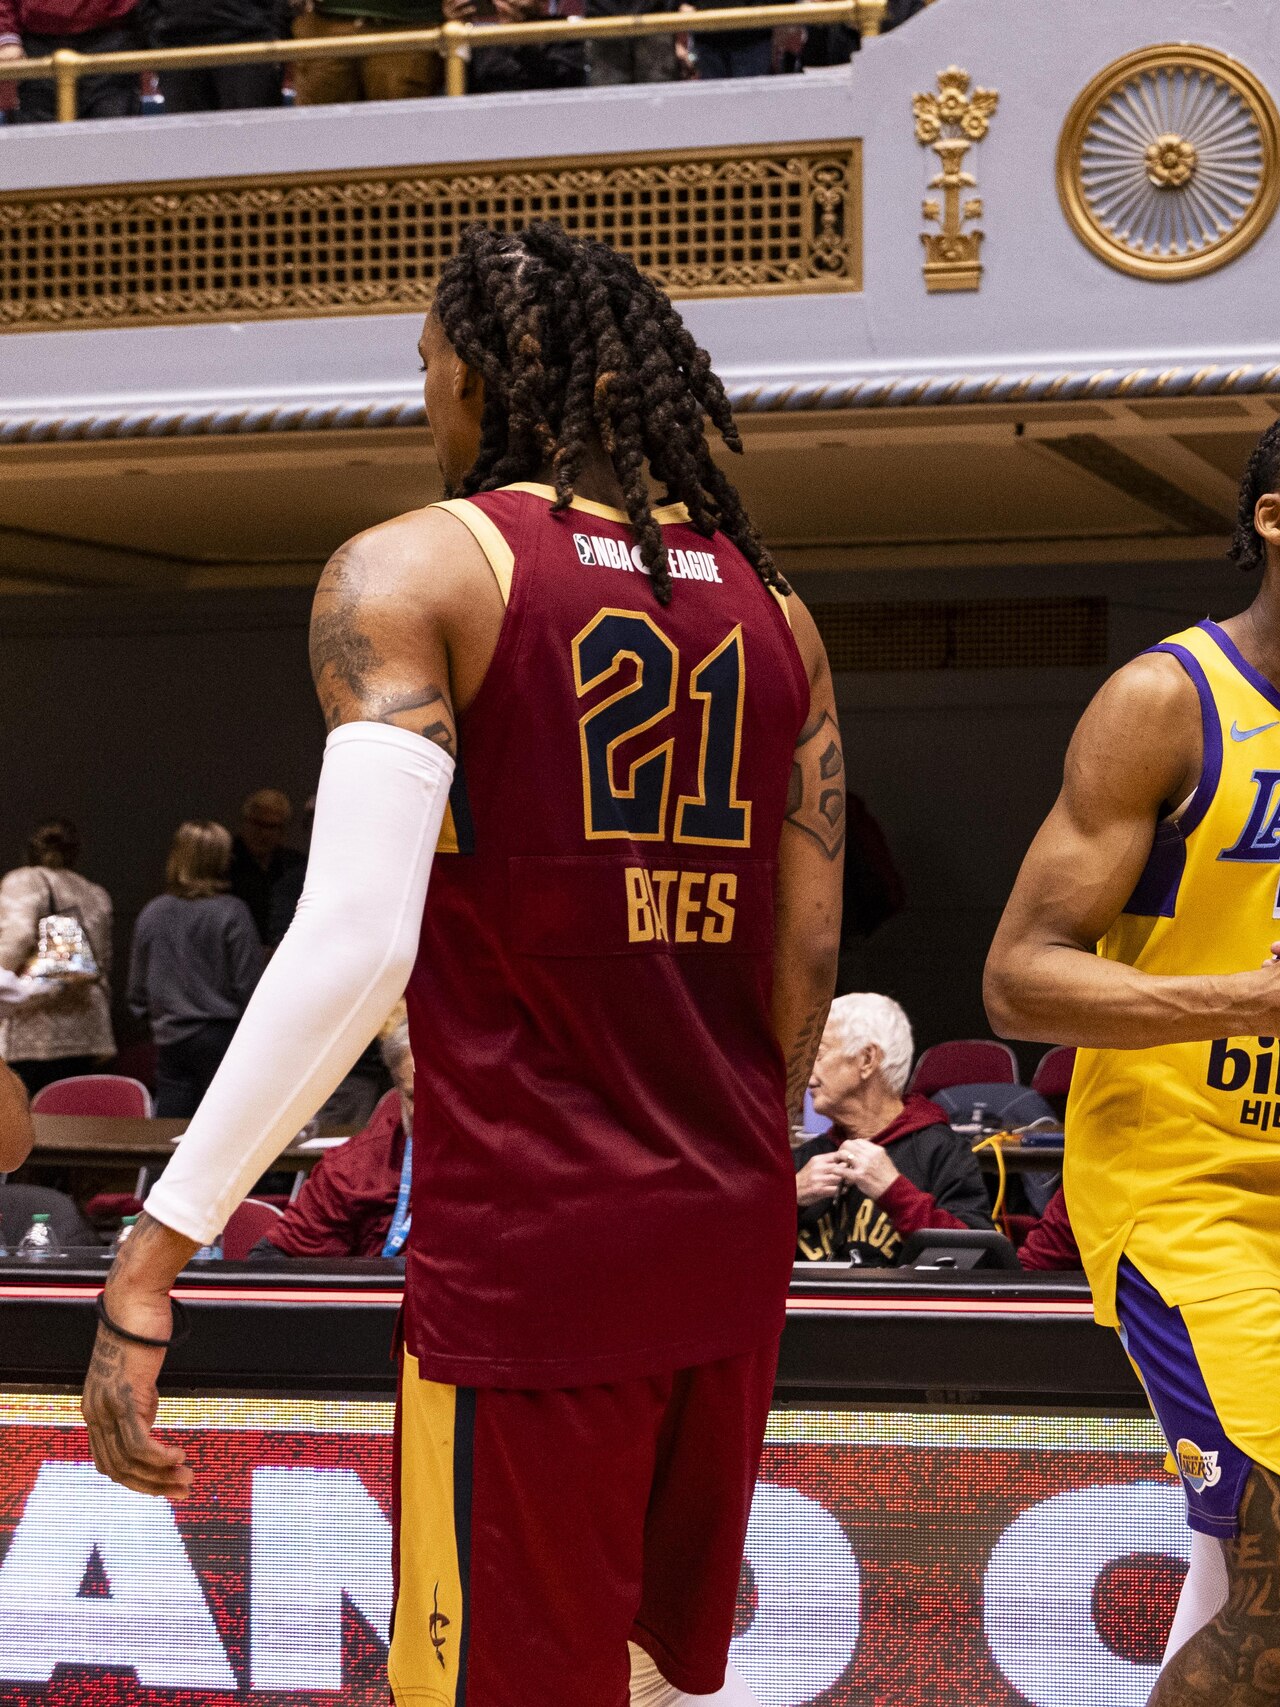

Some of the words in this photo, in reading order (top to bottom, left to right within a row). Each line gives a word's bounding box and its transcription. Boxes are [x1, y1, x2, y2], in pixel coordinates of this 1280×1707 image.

[590, 535, 635, 572] NBA
[667, 548, 723, 584] EAGUE
[571, 607, 752, 848] 21
